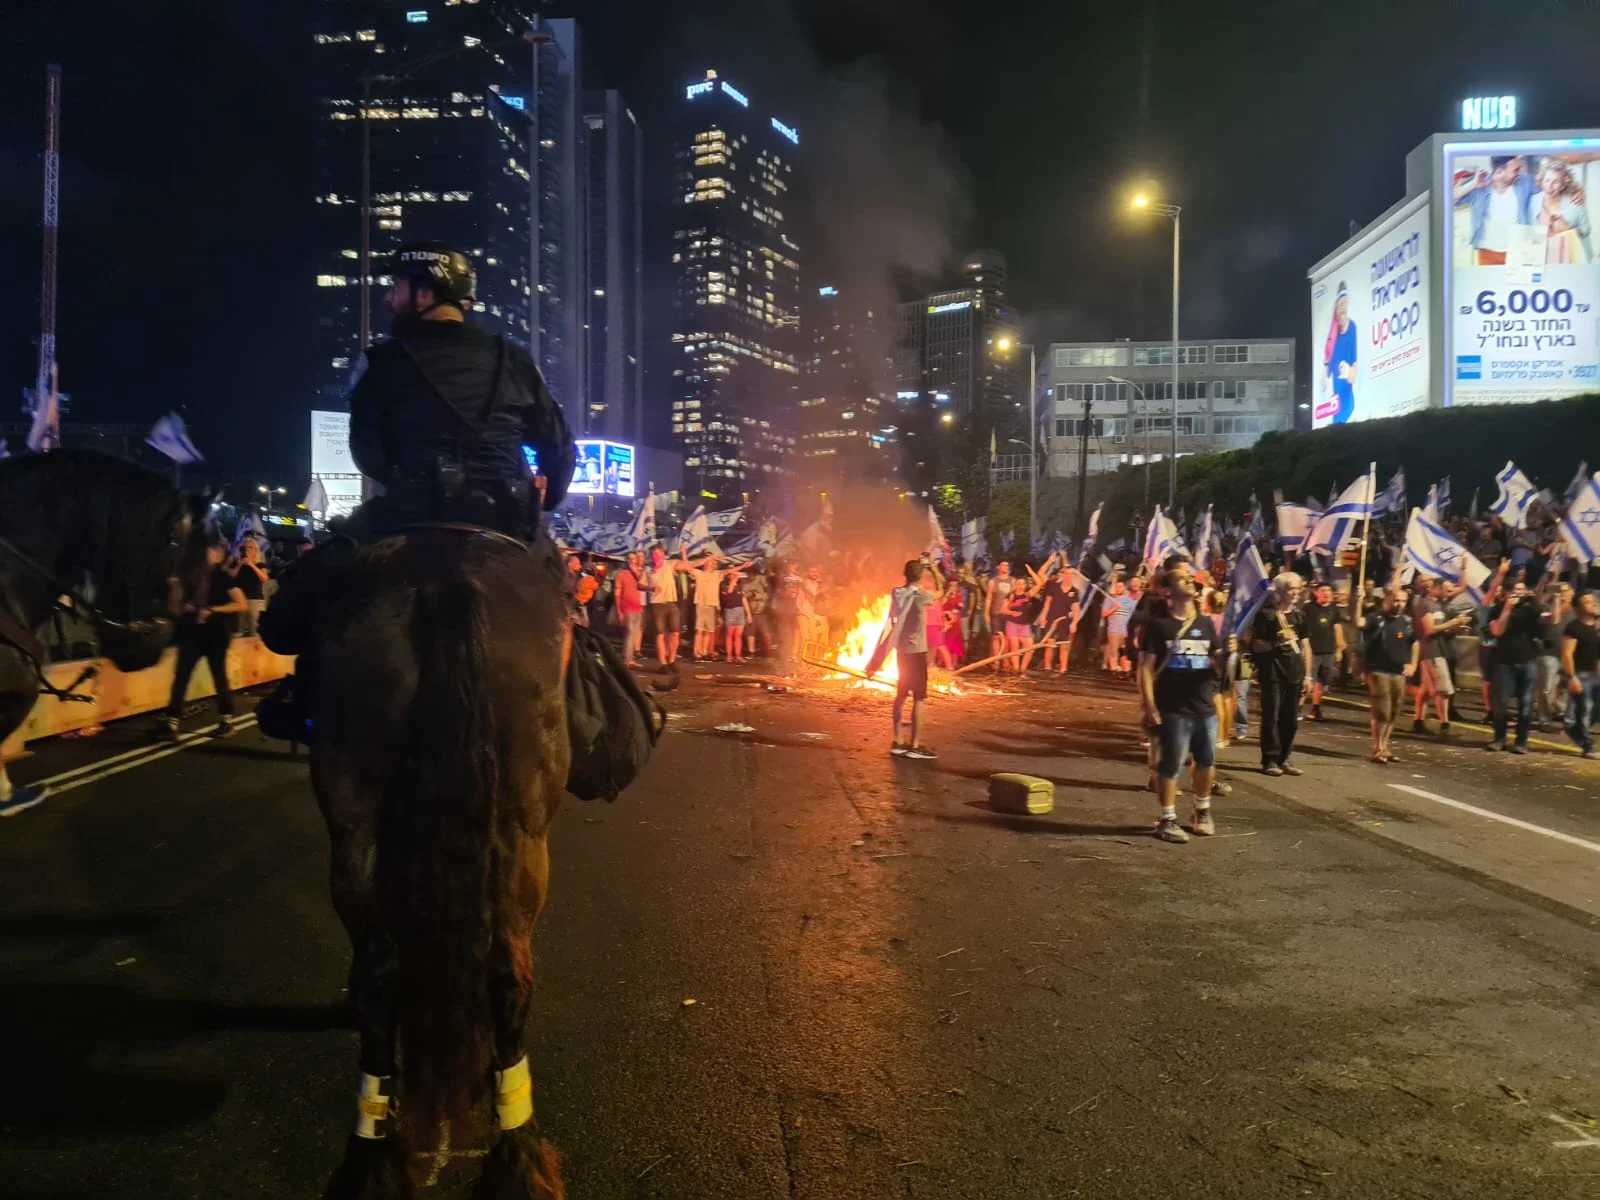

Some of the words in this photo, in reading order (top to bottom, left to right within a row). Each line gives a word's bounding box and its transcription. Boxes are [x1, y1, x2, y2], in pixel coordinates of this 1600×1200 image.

[687, 81, 714, 99] pwc
[400, 250, 451, 264] משטרה
[1476, 288, 1573, 317] 6,000
[1372, 301, 1420, 349] upapp
[1482, 318, 1526, 333] בשנה
[1529, 318, 1571, 332] החזר
[1533, 334, 1577, 351] בארץ
